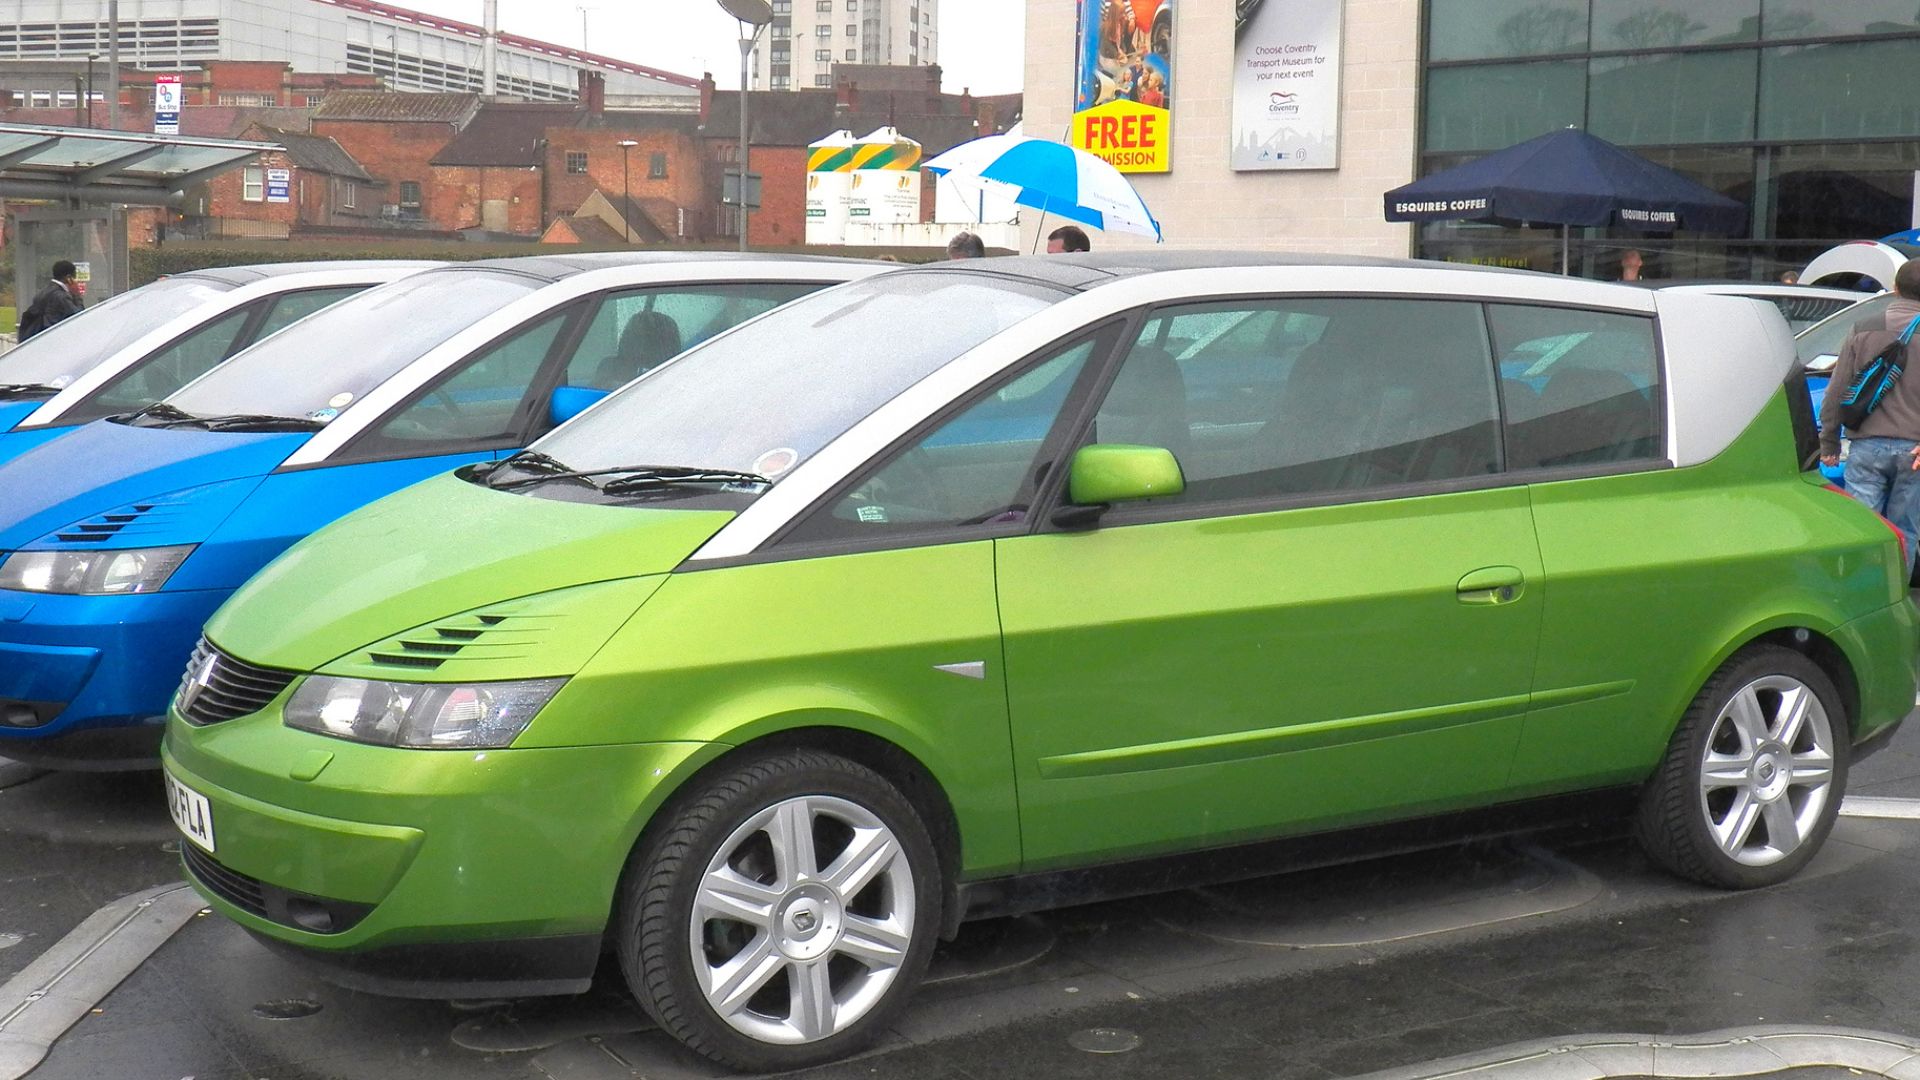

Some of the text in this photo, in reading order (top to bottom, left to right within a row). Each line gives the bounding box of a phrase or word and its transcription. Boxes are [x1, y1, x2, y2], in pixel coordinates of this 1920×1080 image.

[1256, 44, 1317, 55] Choose Coventry
[1247, 60, 1281, 68] Transport
[1314, 56, 1325, 64] for
[1257, 70, 1314, 81] your next event
[1269, 104, 1299, 114] Coventry
[1085, 114, 1156, 149] FREE
[1093, 152, 1155, 165] MISSION
[1396, 199, 1487, 213] ESQUIRES COFFEE
[1621, 208, 1676, 222] ESQUIRES COFFEE
[178, 787, 207, 840] FLA
